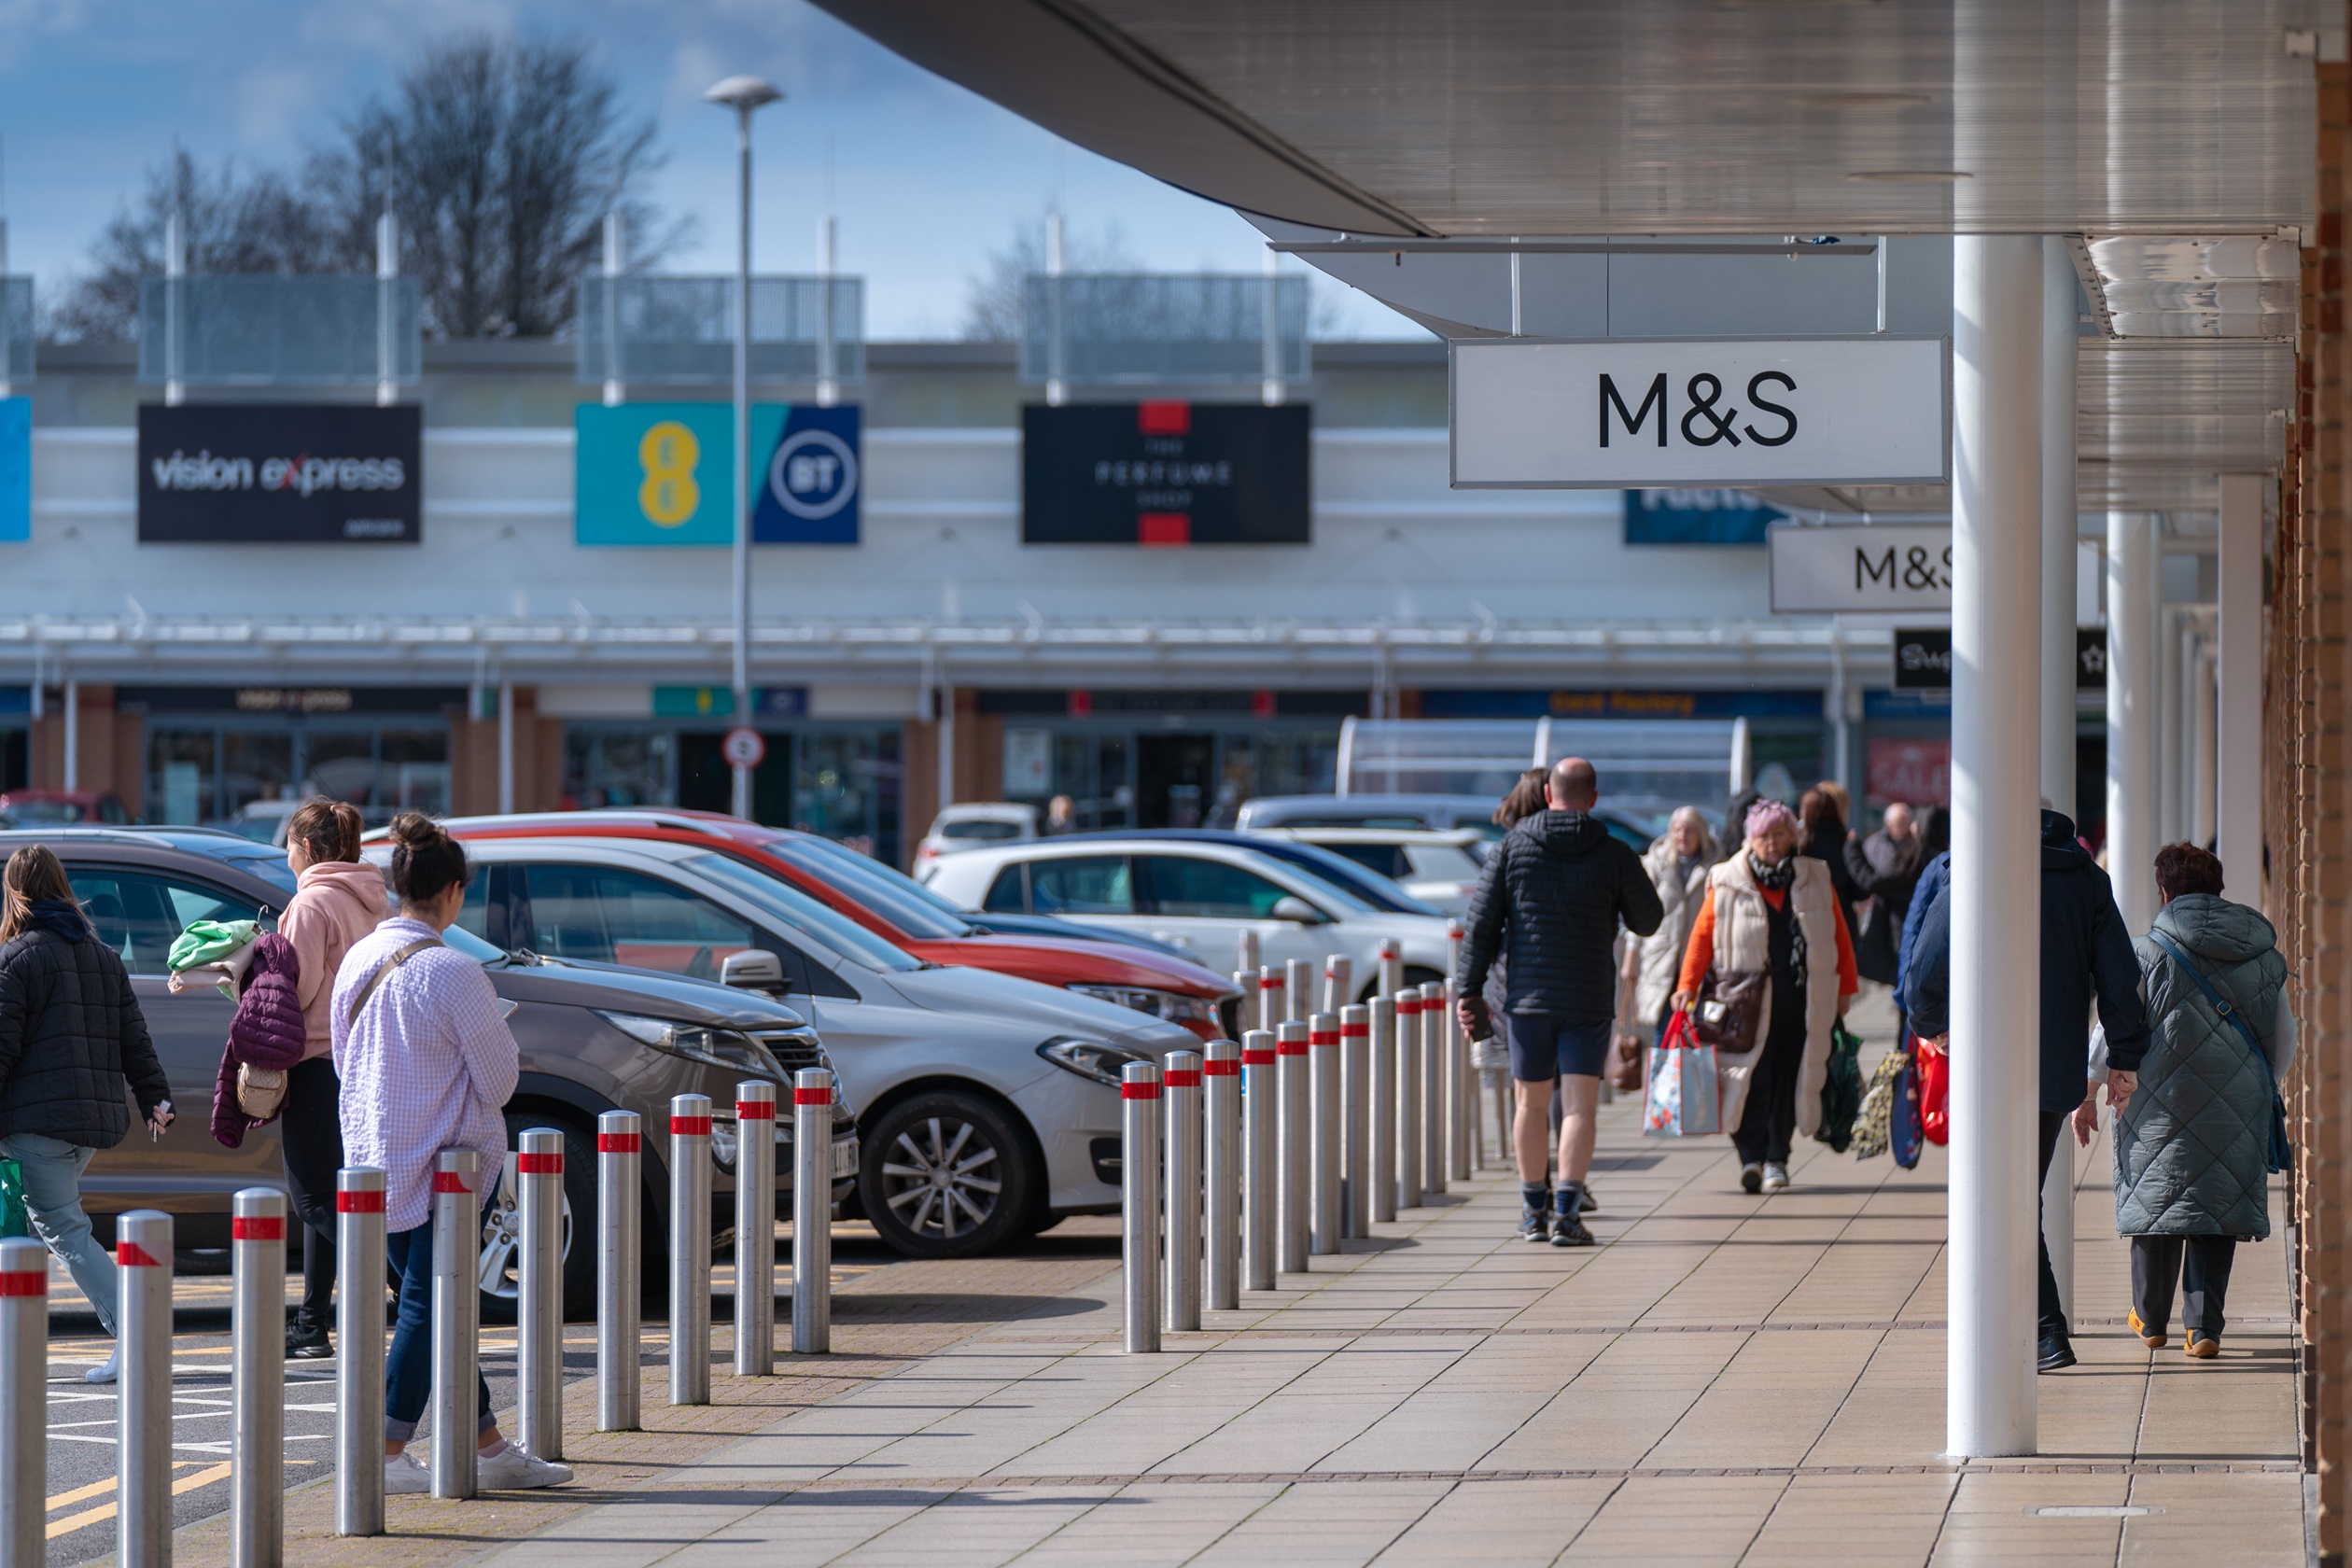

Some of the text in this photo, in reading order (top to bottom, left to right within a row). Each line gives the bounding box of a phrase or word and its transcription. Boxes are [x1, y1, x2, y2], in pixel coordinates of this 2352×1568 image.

[1599, 370, 1799, 448] M&S
[152, 449, 405, 497] vision express
[789, 455, 838, 494] BT
[1095, 460, 1232, 486] PERFUME
